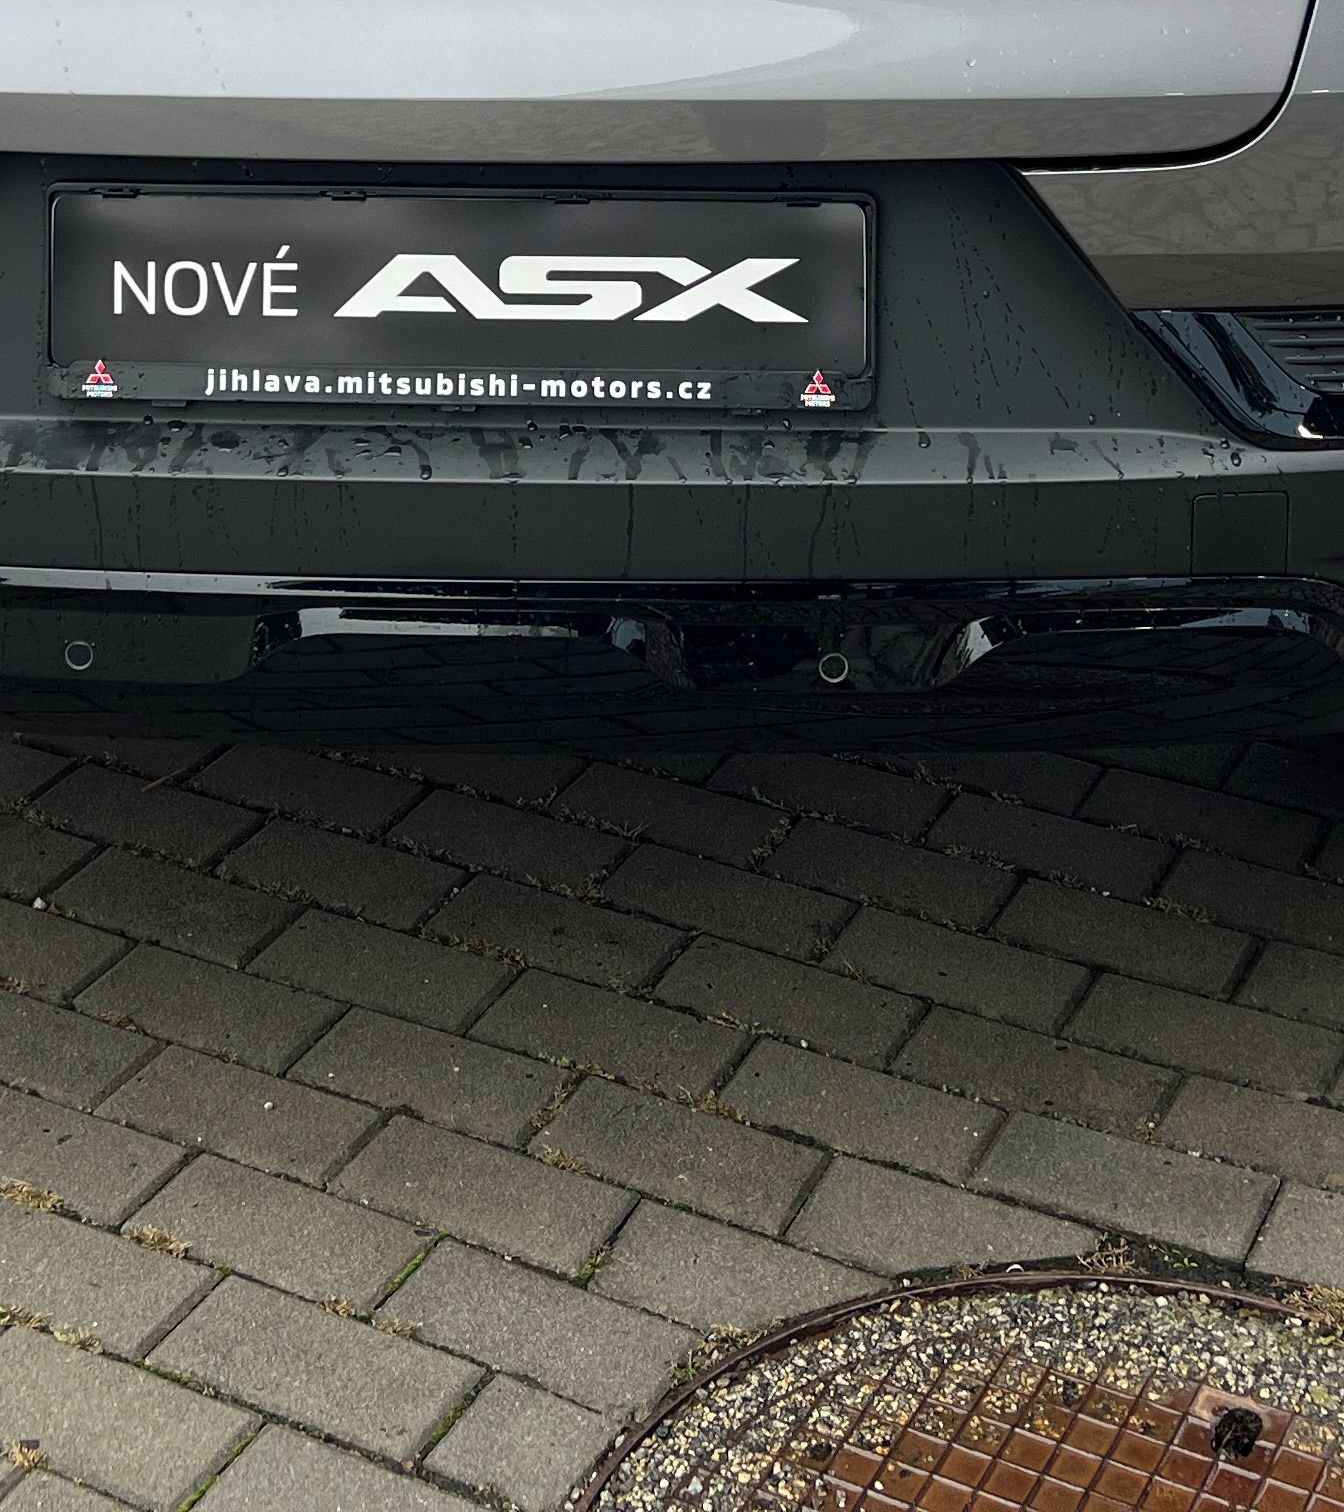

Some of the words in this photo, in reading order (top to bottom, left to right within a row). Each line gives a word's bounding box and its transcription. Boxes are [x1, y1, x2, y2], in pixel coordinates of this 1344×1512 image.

[112, 245, 299, 318] NOVÉ
[334, 254, 809, 323] ASX
[204, 367, 712, 400] jihlava.mitsubishi-motors.cz
